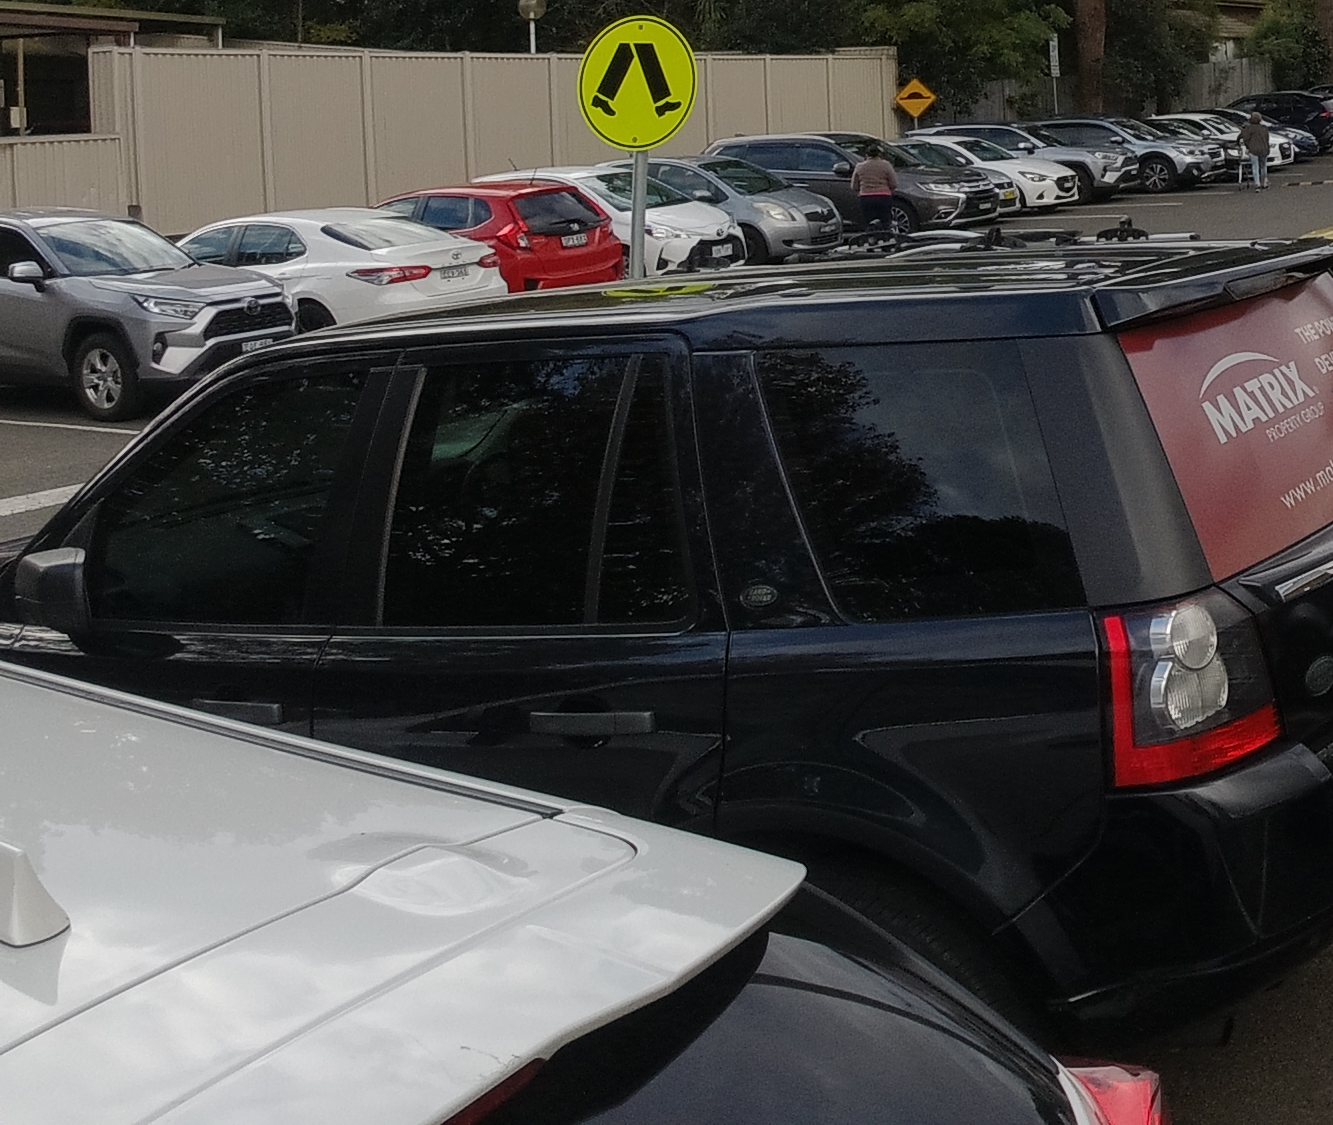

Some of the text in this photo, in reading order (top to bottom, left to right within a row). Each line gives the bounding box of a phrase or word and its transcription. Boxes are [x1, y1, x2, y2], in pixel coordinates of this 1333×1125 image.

[1294, 324, 1319, 344] THE
[1201, 361, 1315, 445] MATRIX
[1266, 402, 1325, 442] PROPERTY GROUP
